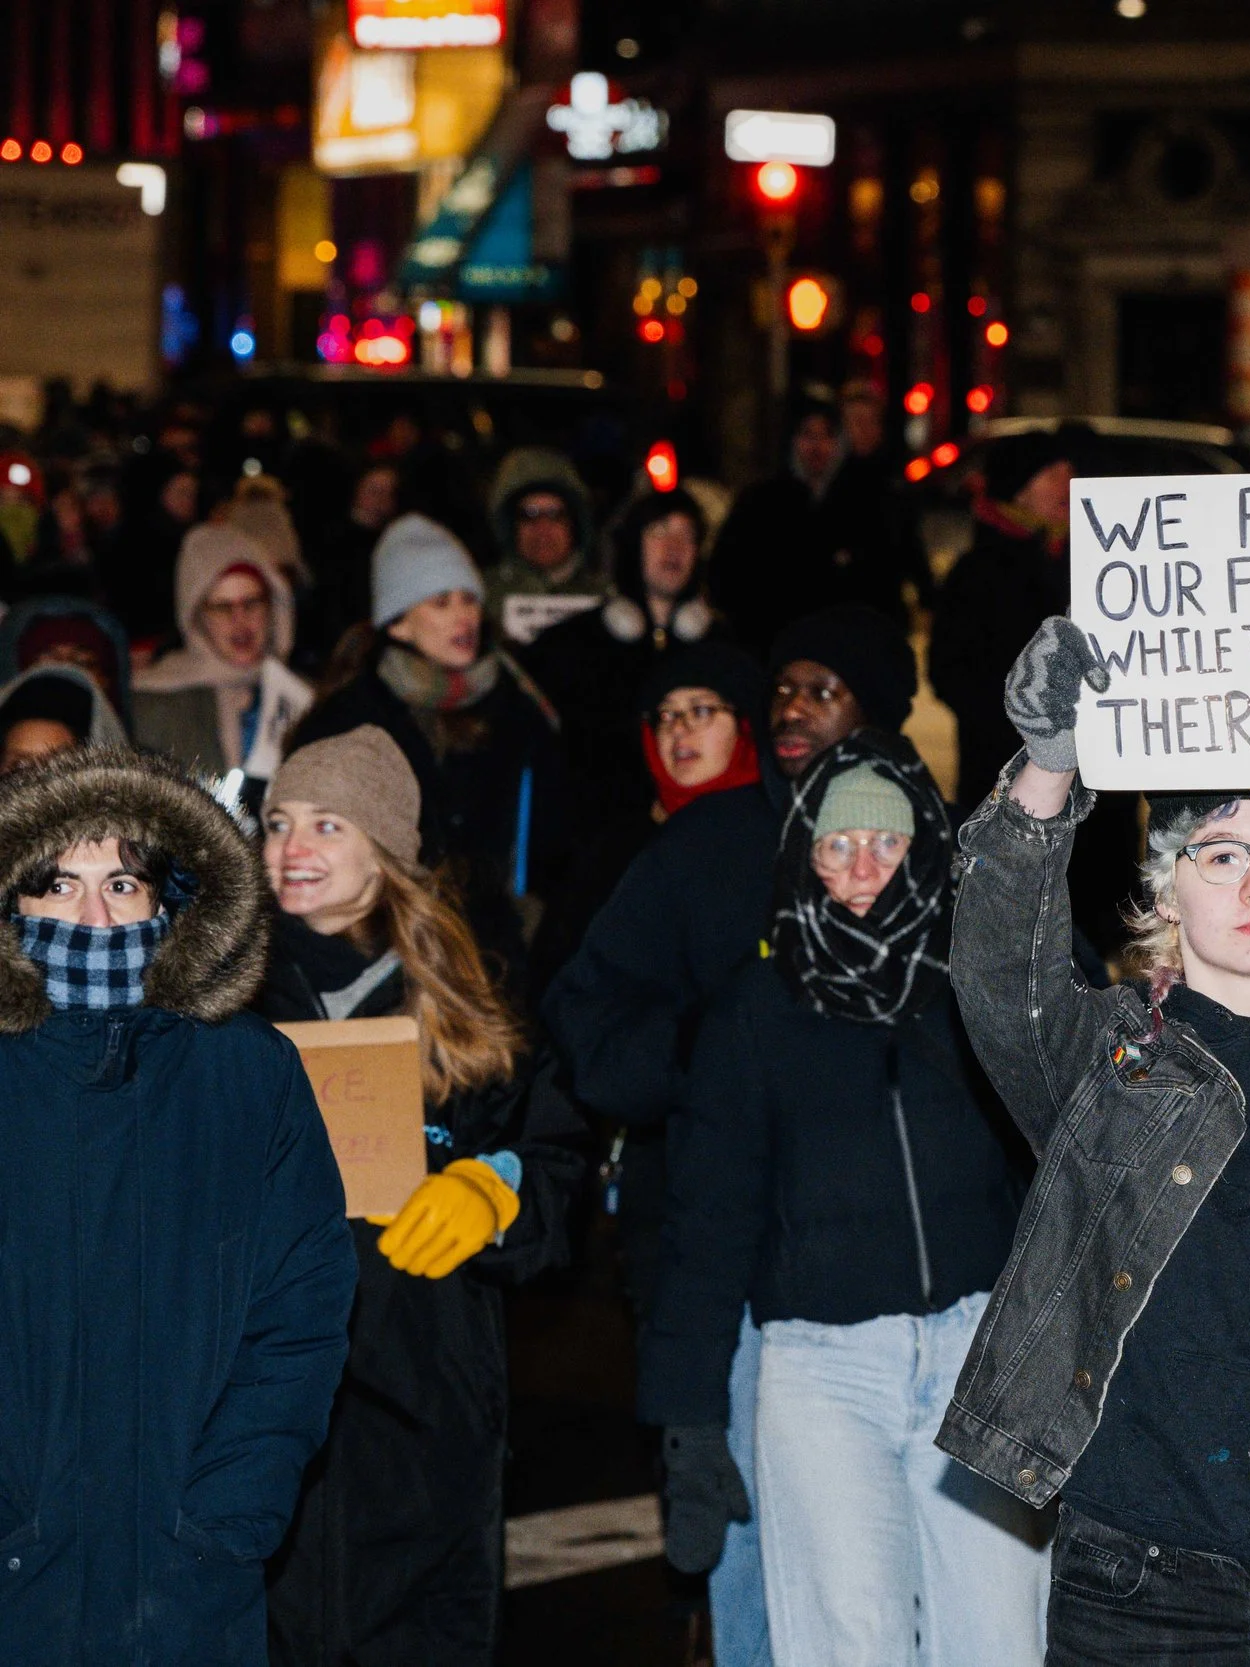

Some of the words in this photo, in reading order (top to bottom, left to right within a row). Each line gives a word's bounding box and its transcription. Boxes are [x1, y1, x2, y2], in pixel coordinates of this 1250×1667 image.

[1081, 493, 1189, 552] WE
[1095, 560, 1206, 621] OUR
[1087, 627, 1233, 677] WHILE
